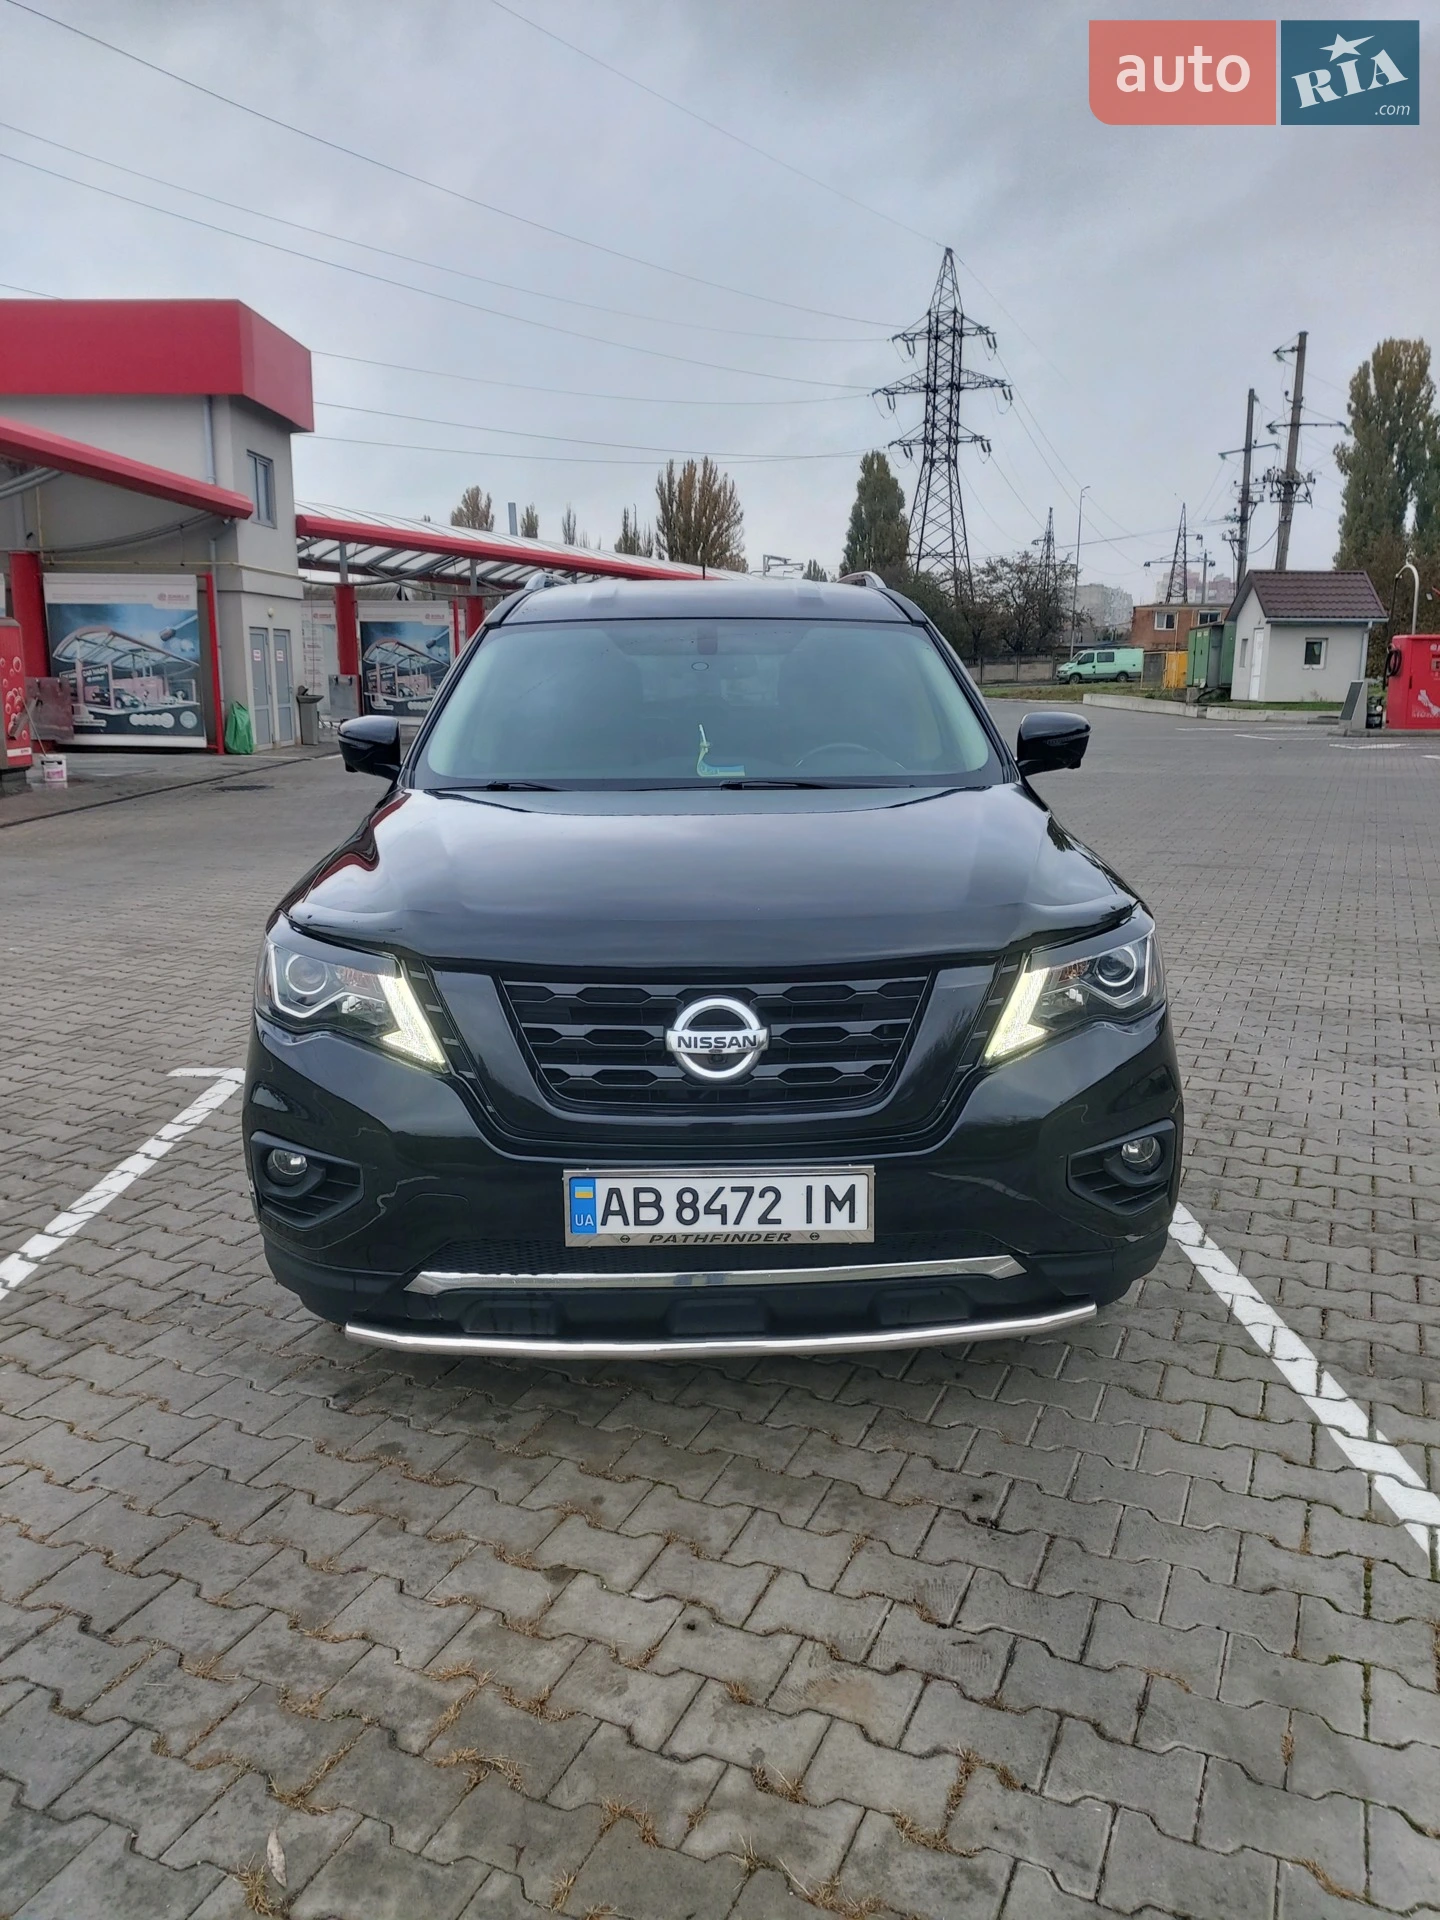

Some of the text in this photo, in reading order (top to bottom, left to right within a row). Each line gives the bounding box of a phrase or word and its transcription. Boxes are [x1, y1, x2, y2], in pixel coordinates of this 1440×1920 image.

[677, 1035, 757, 1049] NISSAN
[574, 1183, 856, 1227] UA AB 8472 IM
[648, 1232, 792, 1244] PATHFINDER
